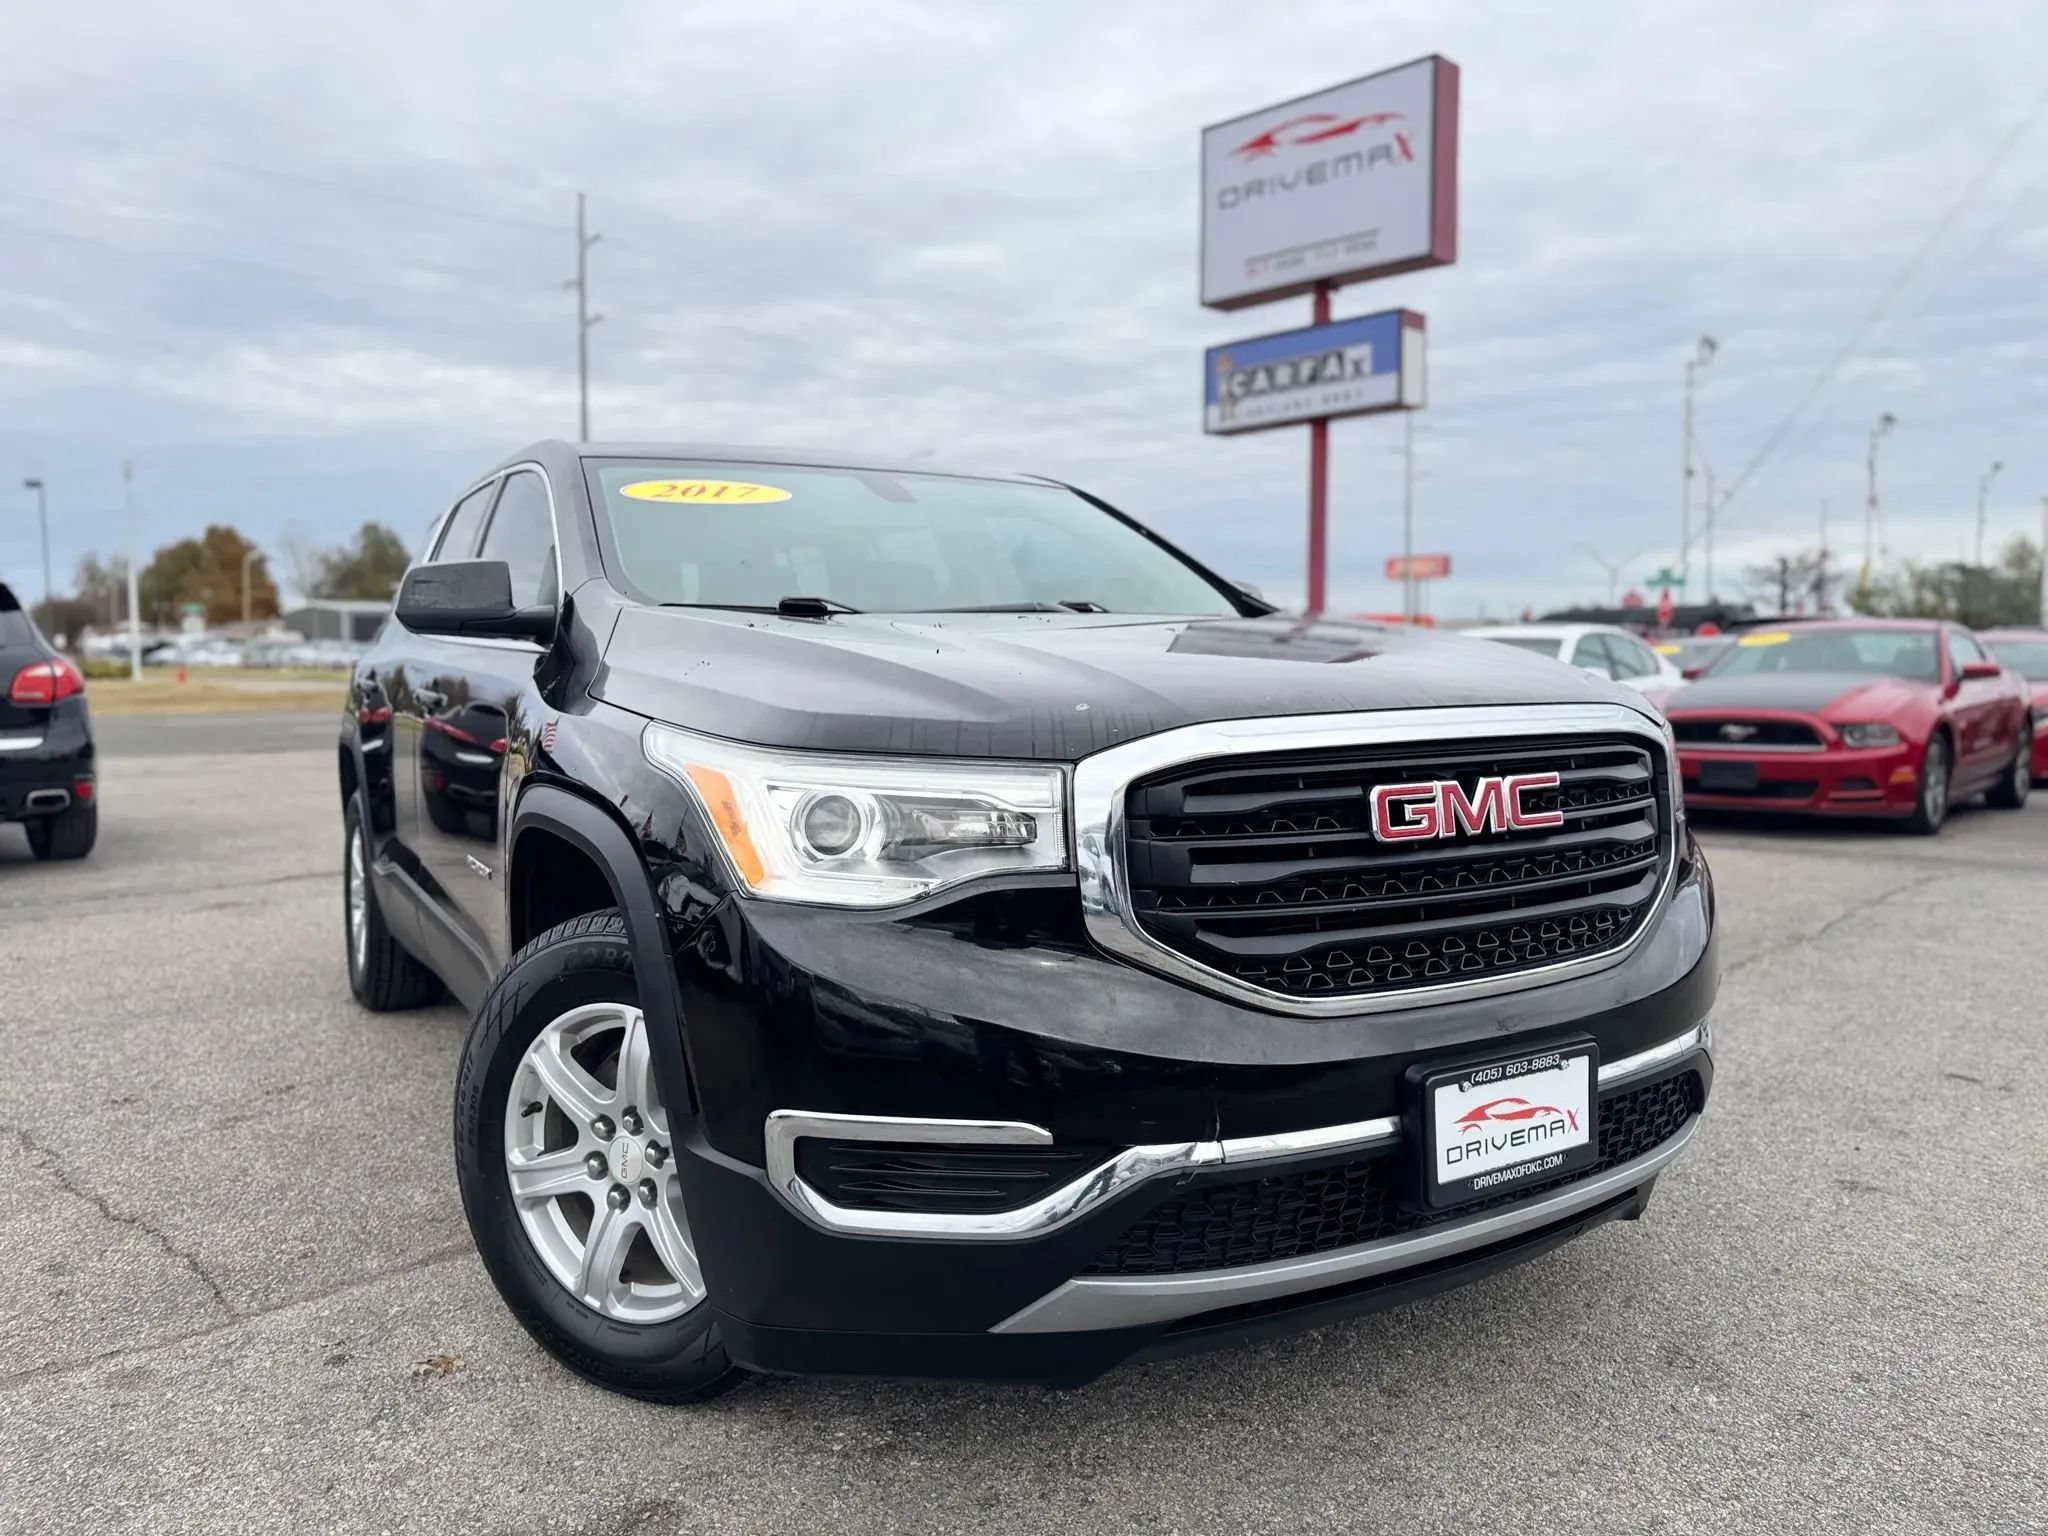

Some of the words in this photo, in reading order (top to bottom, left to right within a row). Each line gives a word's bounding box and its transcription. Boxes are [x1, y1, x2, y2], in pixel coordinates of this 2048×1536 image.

[1216, 131, 1414, 211] DRIVEMAX
[652, 484, 760, 498] 2017
[1370, 771, 1564, 843] GMC
[1471, 1067, 1502, 1084] (405)
[1506, 1054, 1560, 1076] 603-8883
[1447, 1108, 1579, 1165] DRIVEMAX
[621, 1142, 630, 1179] GMC
[1473, 1153, 1564, 1190] DRIVEMAXOFOKC.COM
